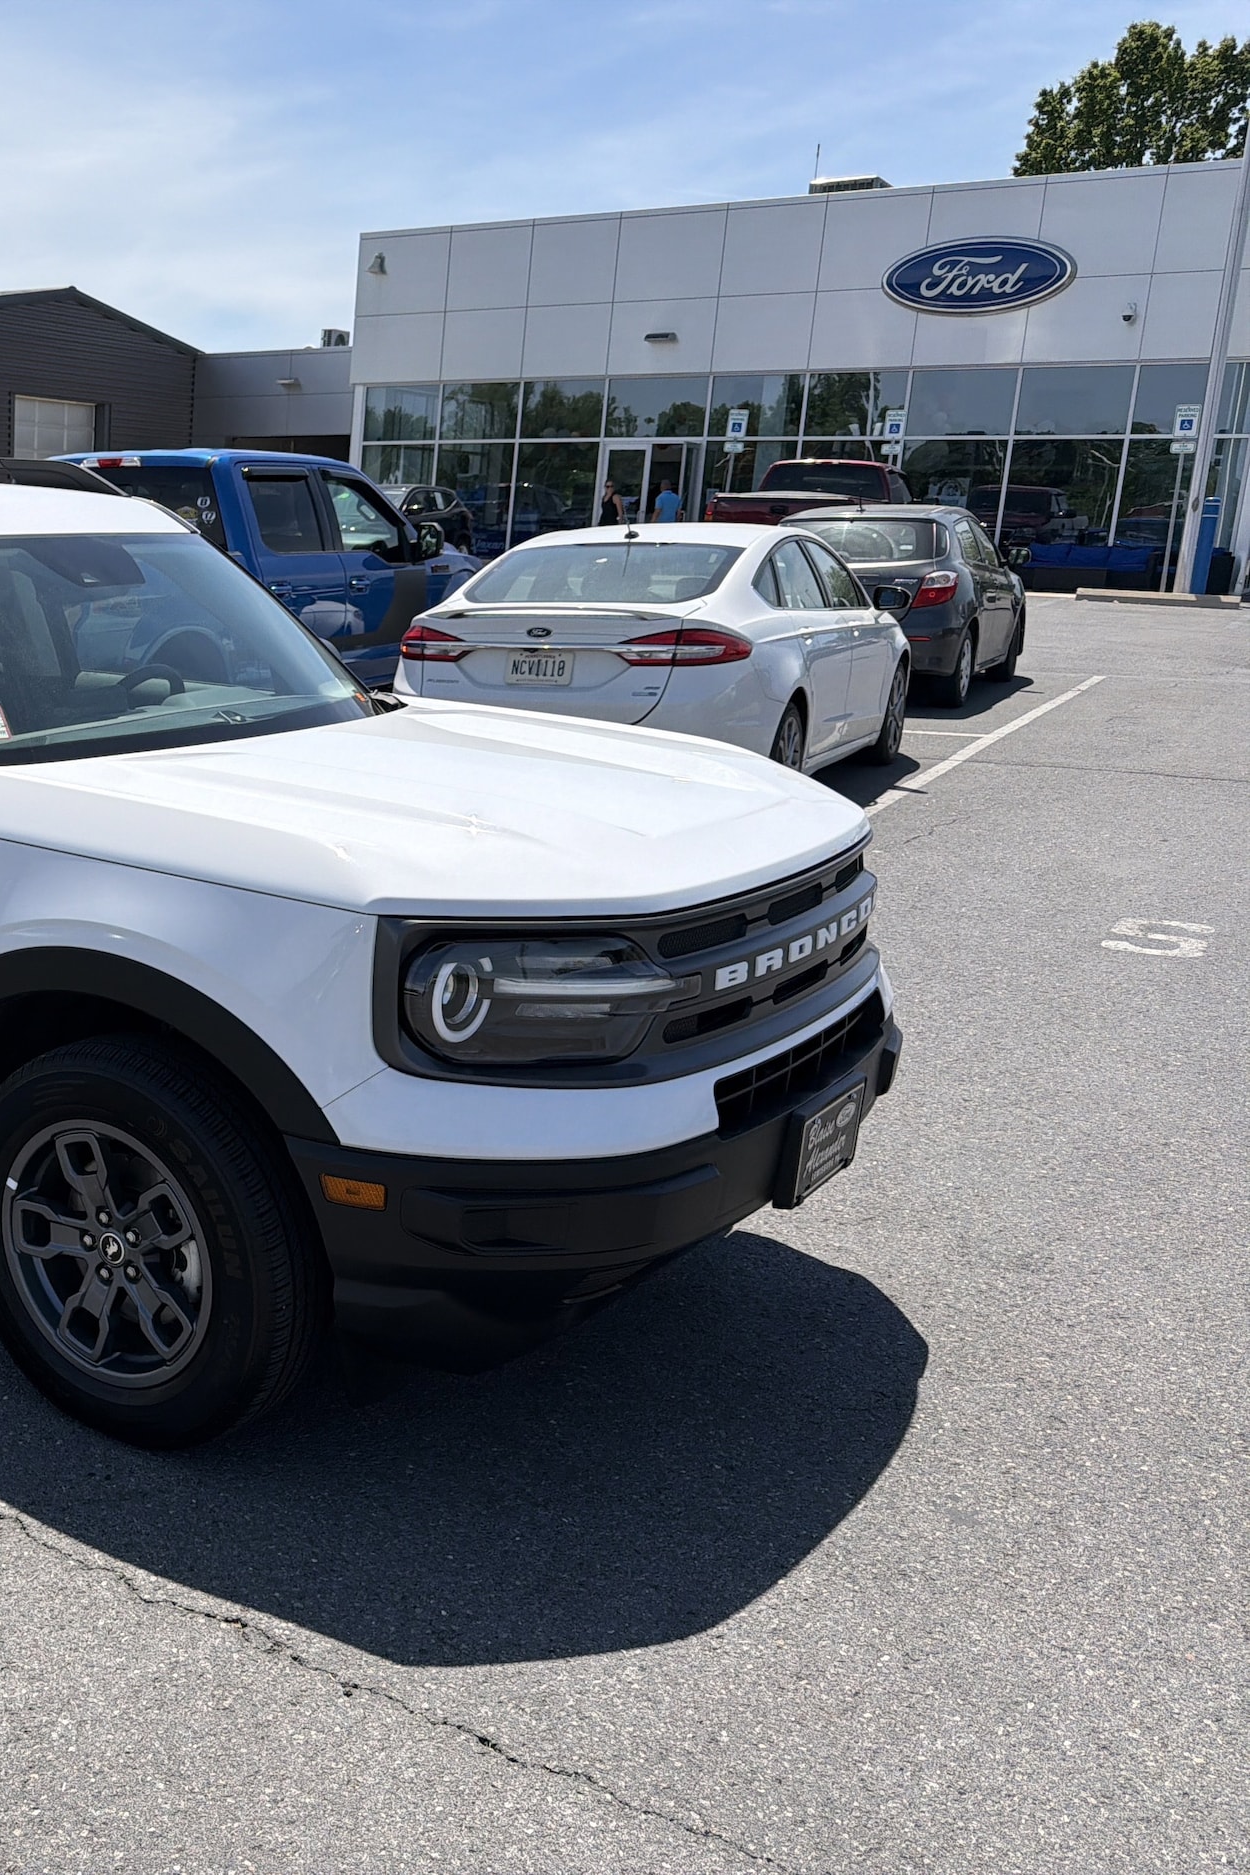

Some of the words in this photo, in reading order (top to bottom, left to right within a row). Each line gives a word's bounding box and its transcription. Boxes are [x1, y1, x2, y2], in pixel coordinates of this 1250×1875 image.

[920, 255, 1029, 298] Ford
[511, 659, 566, 677] NCV1118
[715, 896, 874, 991] BRONCO
